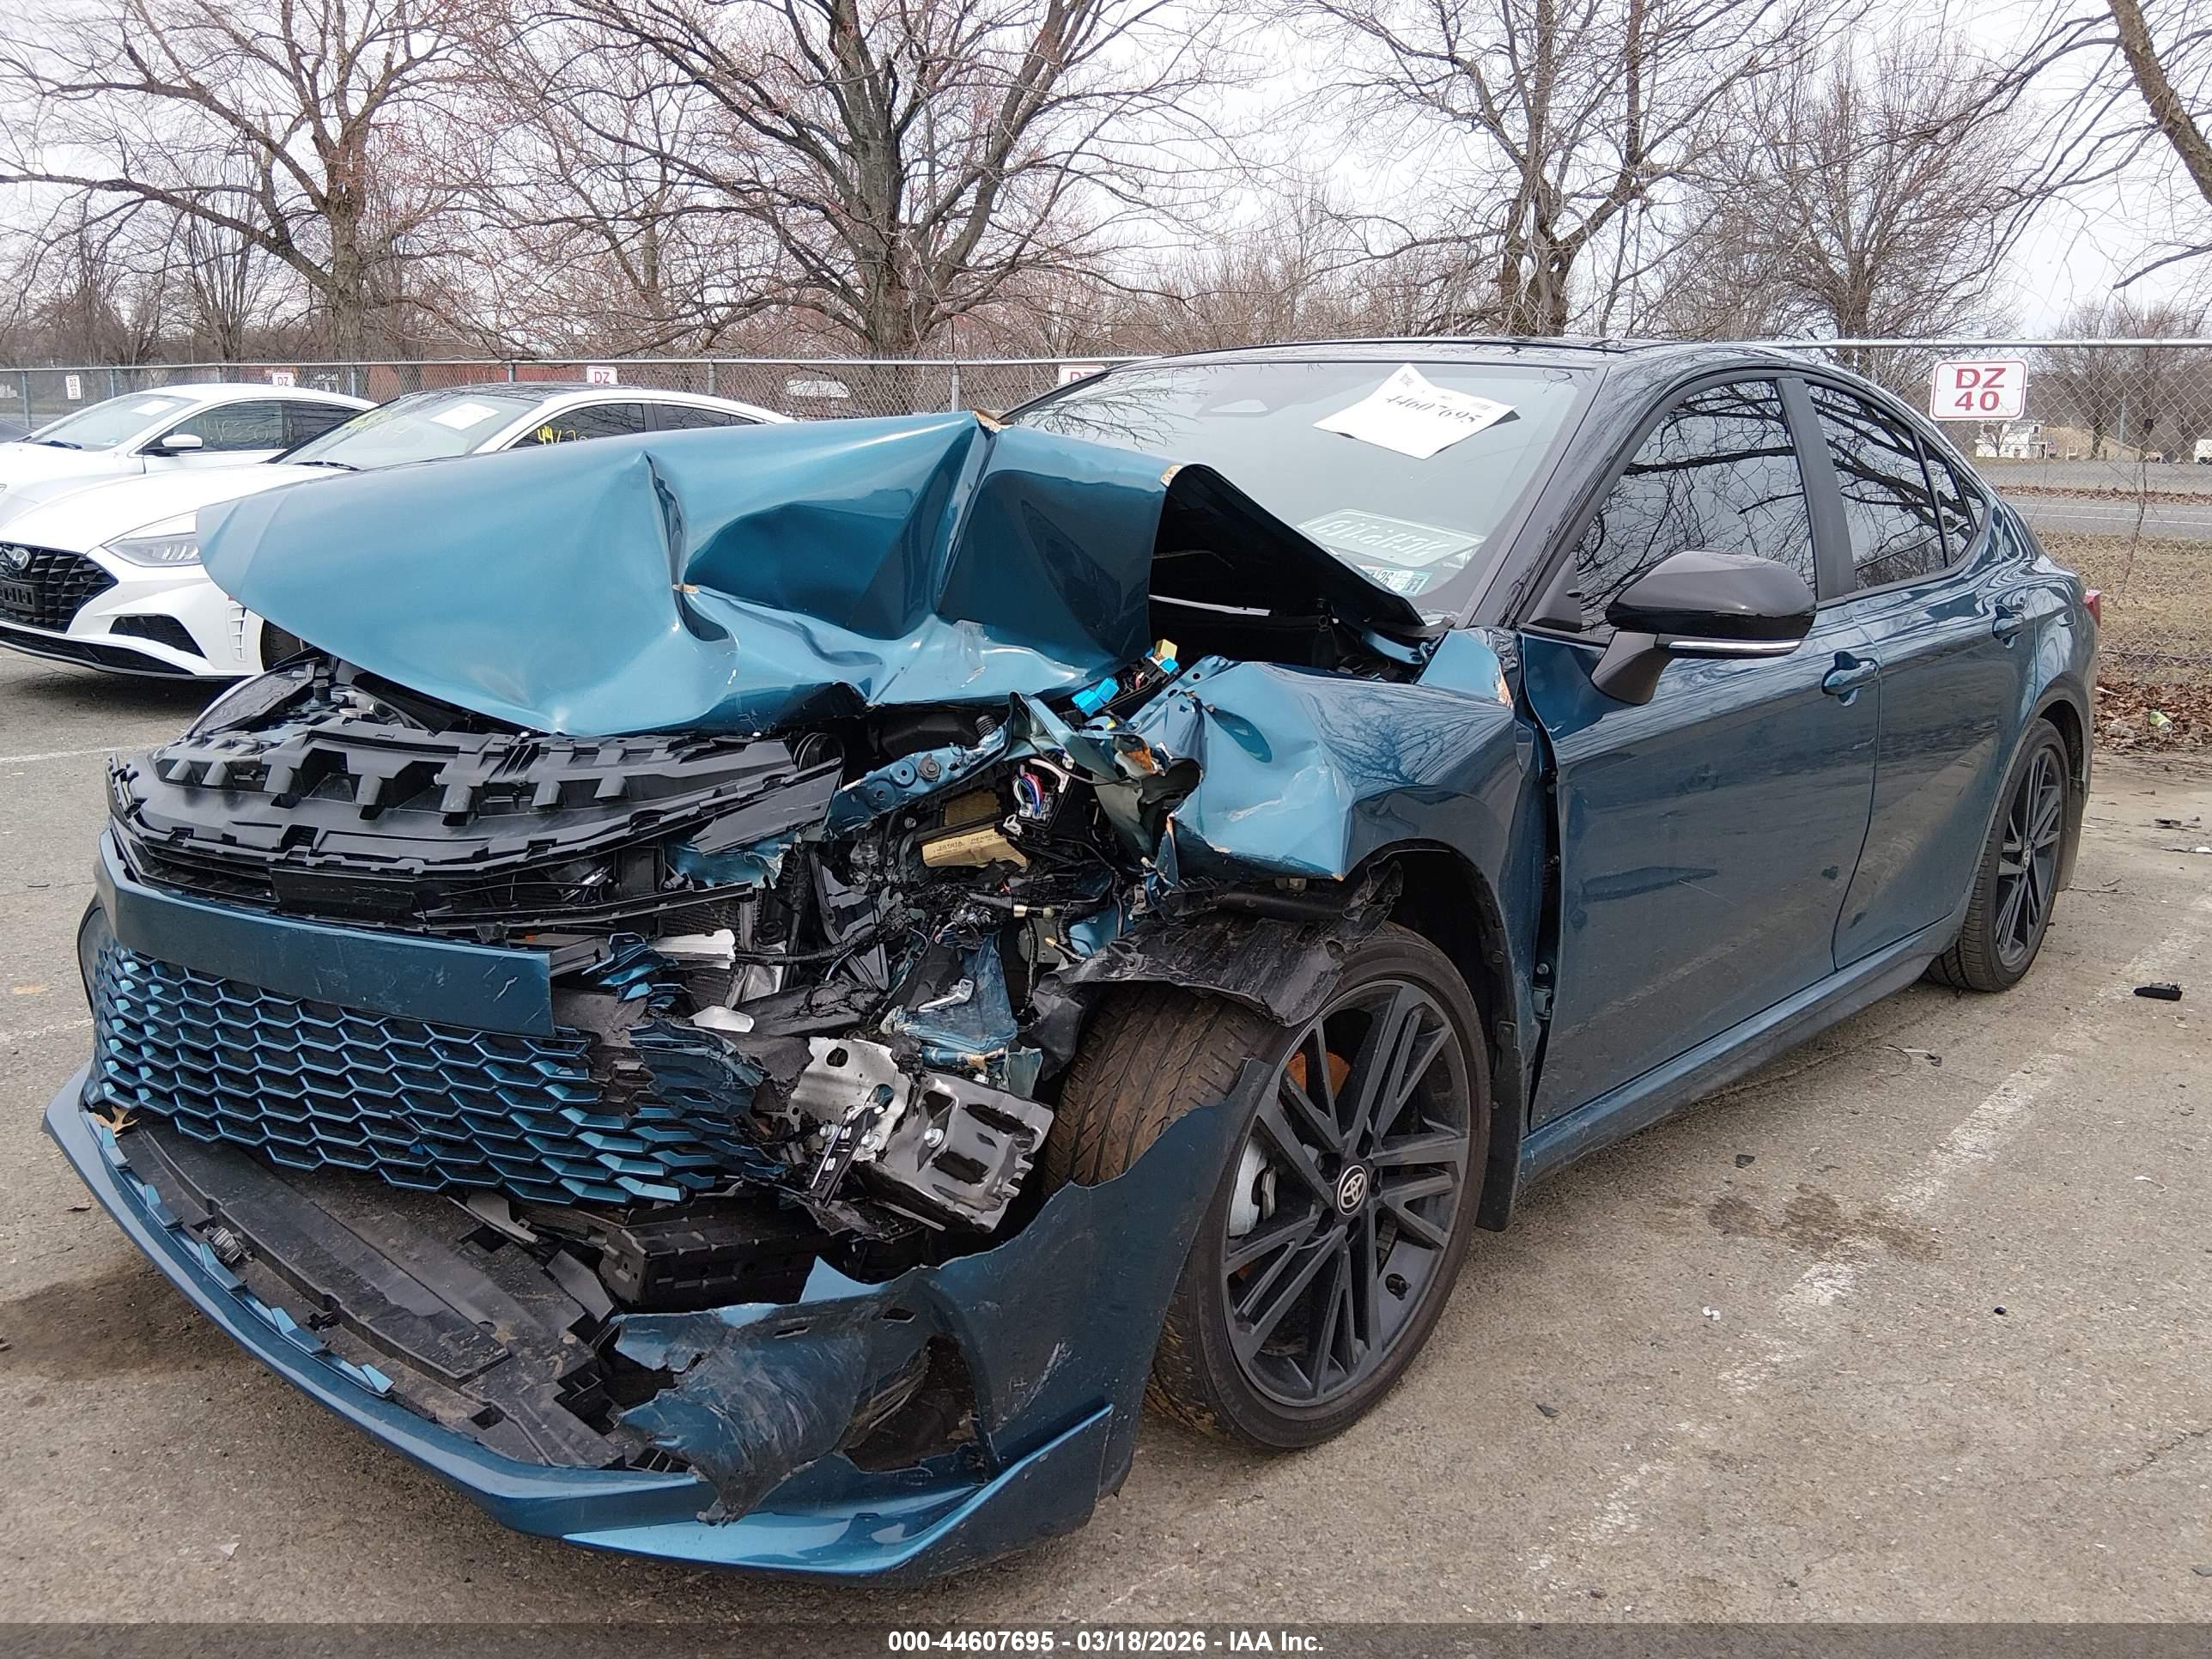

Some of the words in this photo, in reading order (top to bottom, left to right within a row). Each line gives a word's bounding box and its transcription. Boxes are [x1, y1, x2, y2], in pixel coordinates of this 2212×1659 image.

[277, 376, 289, 386] DZ
[594, 371, 611, 384] DZ
[1955, 368, 2007, 389] DZ
[1954, 391, 2000, 411] 40
